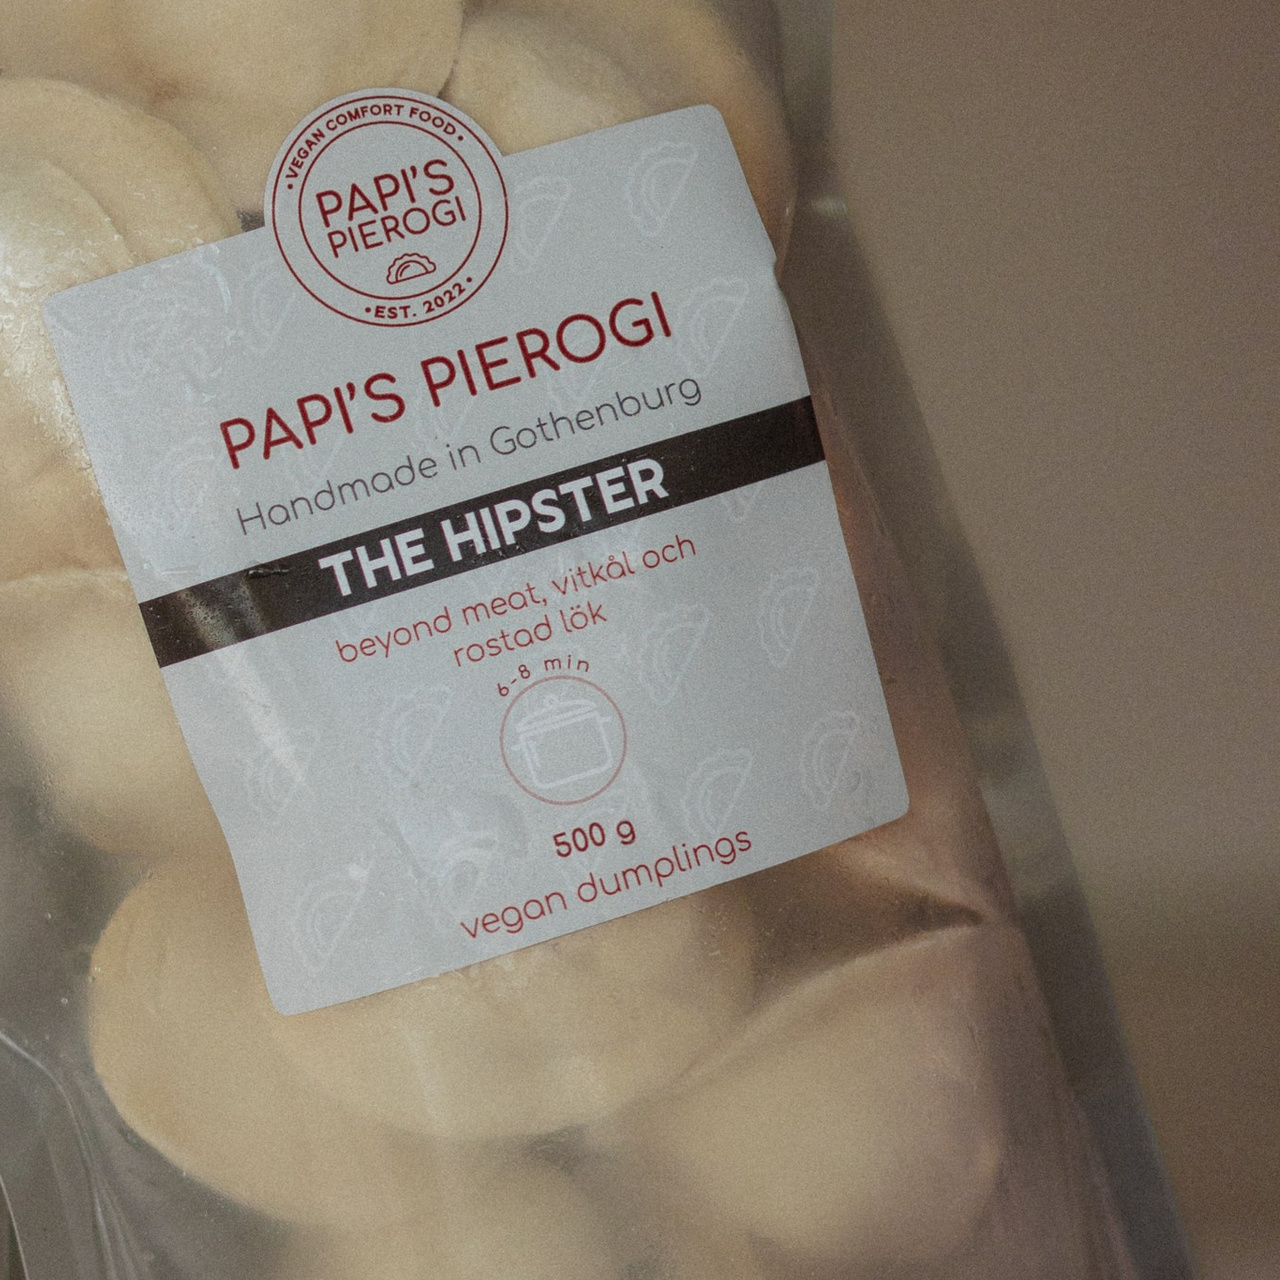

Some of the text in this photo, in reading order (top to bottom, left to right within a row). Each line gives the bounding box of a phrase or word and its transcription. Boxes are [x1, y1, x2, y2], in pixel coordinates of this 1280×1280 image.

[285, 104, 457, 179] VEGAN COMFORT FOOD
[316, 159, 455, 228] PAPI'S
[327, 195, 467, 259] PIEROGI
[374, 282, 466, 319] EST. 2022
[219, 291, 672, 470] PAPI'S PIEROGI
[235, 377, 702, 536] Handmade in Gothenburg
[318, 457, 670, 597] THE HIPSTER
[336, 535, 697, 663] beyond meat, vitkål och
[453, 601, 607, 668] rostad lök
[497, 655, 590, 697] 6-8 min
[553, 820, 637, 858] 500 g
[460, 830, 752, 939] vegan dumplings
